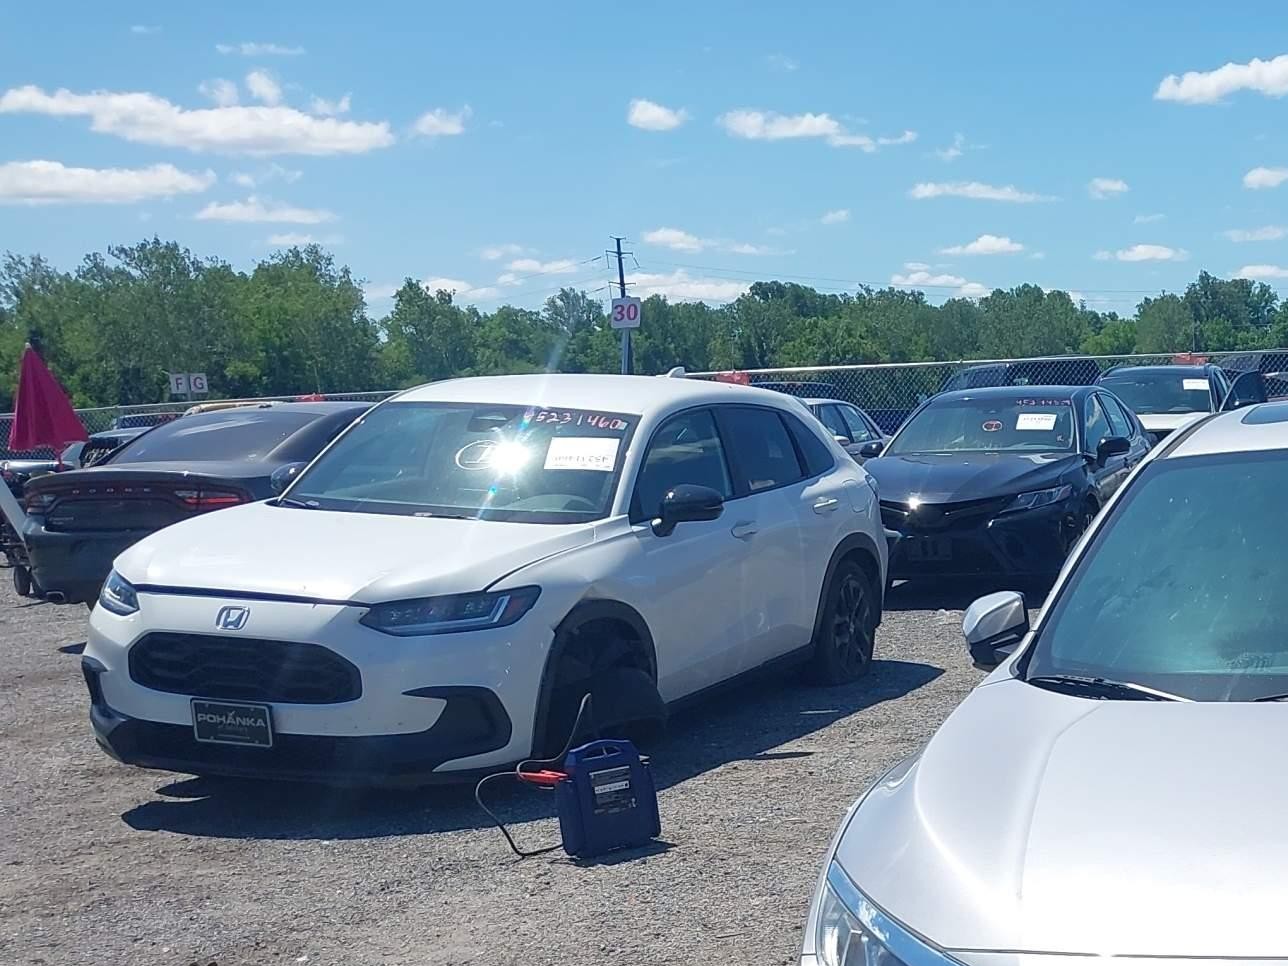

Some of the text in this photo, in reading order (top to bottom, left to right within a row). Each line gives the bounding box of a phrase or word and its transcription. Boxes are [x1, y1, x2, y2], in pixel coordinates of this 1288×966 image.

[613, 303, 638, 322] 30
[175, 376, 204, 391] F G
[197, 712, 266, 728] POHANKA
